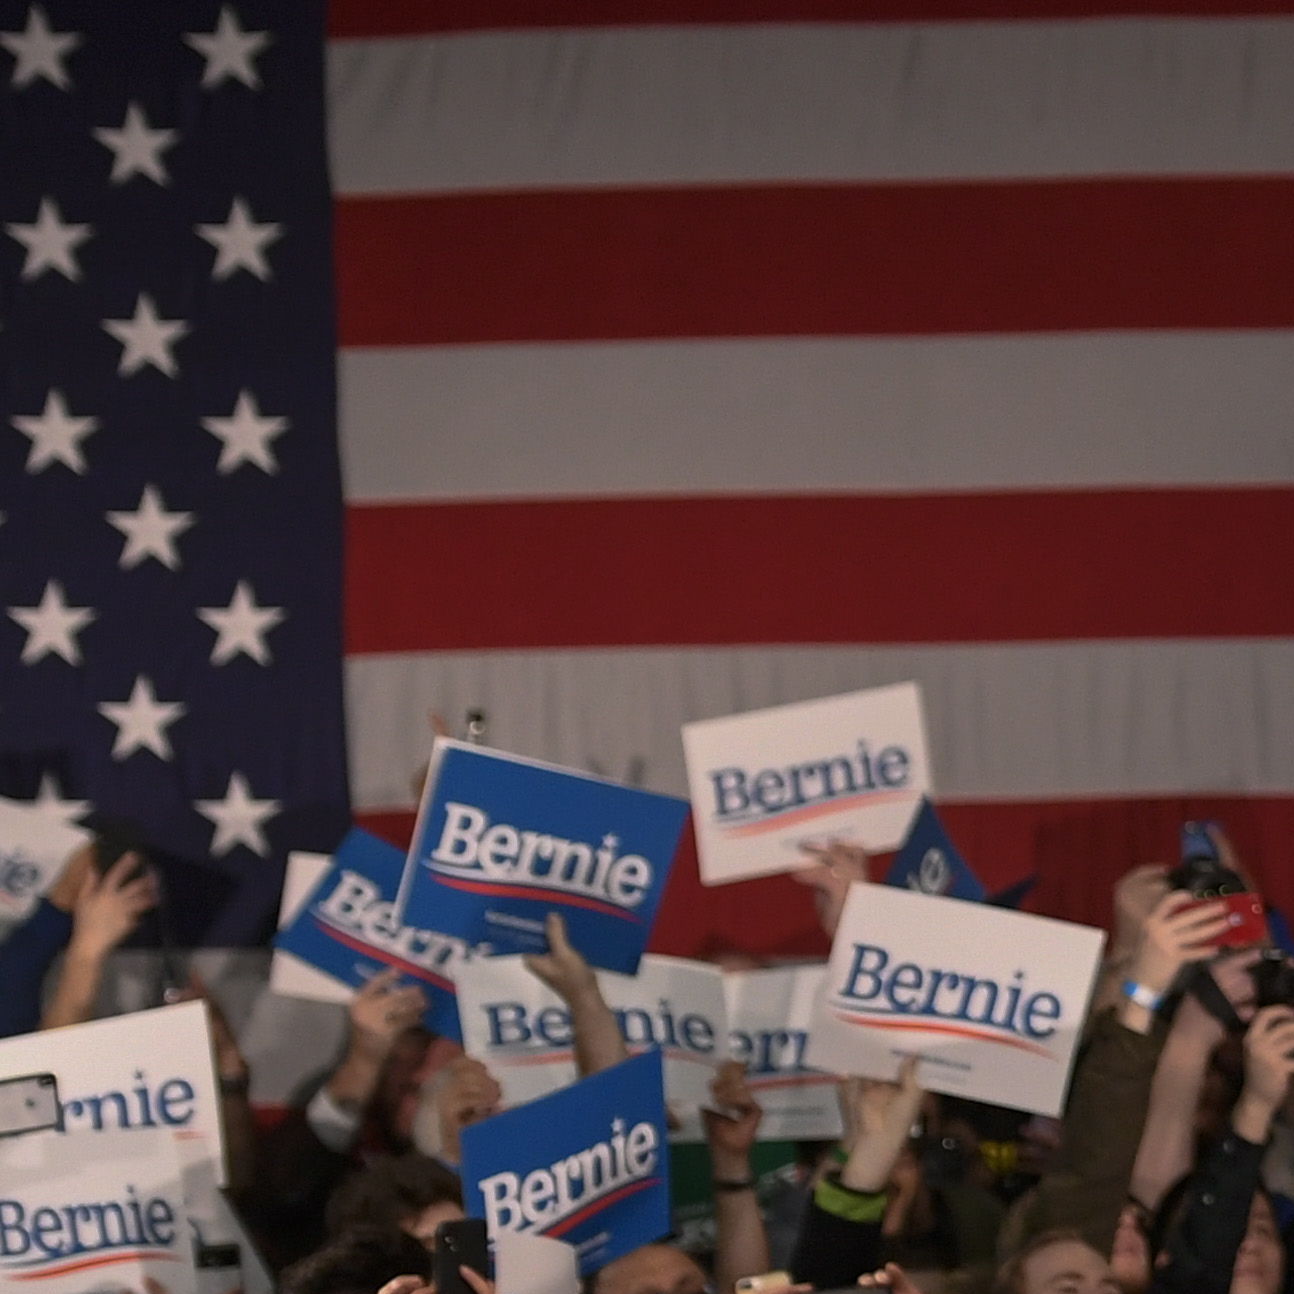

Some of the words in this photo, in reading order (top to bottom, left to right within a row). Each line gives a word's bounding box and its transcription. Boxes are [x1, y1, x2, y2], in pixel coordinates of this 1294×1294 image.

[709, 738, 910, 818] Bernie
[431, 801, 654, 904] Bernie
[482, 999, 714, 1053] Benie
[840, 942, 1062, 1040] Bernie
[56, 1069, 195, 1132] rnie
[478, 1117, 658, 1240] Bernie
[0, 1184, 175, 1257] Bernie
